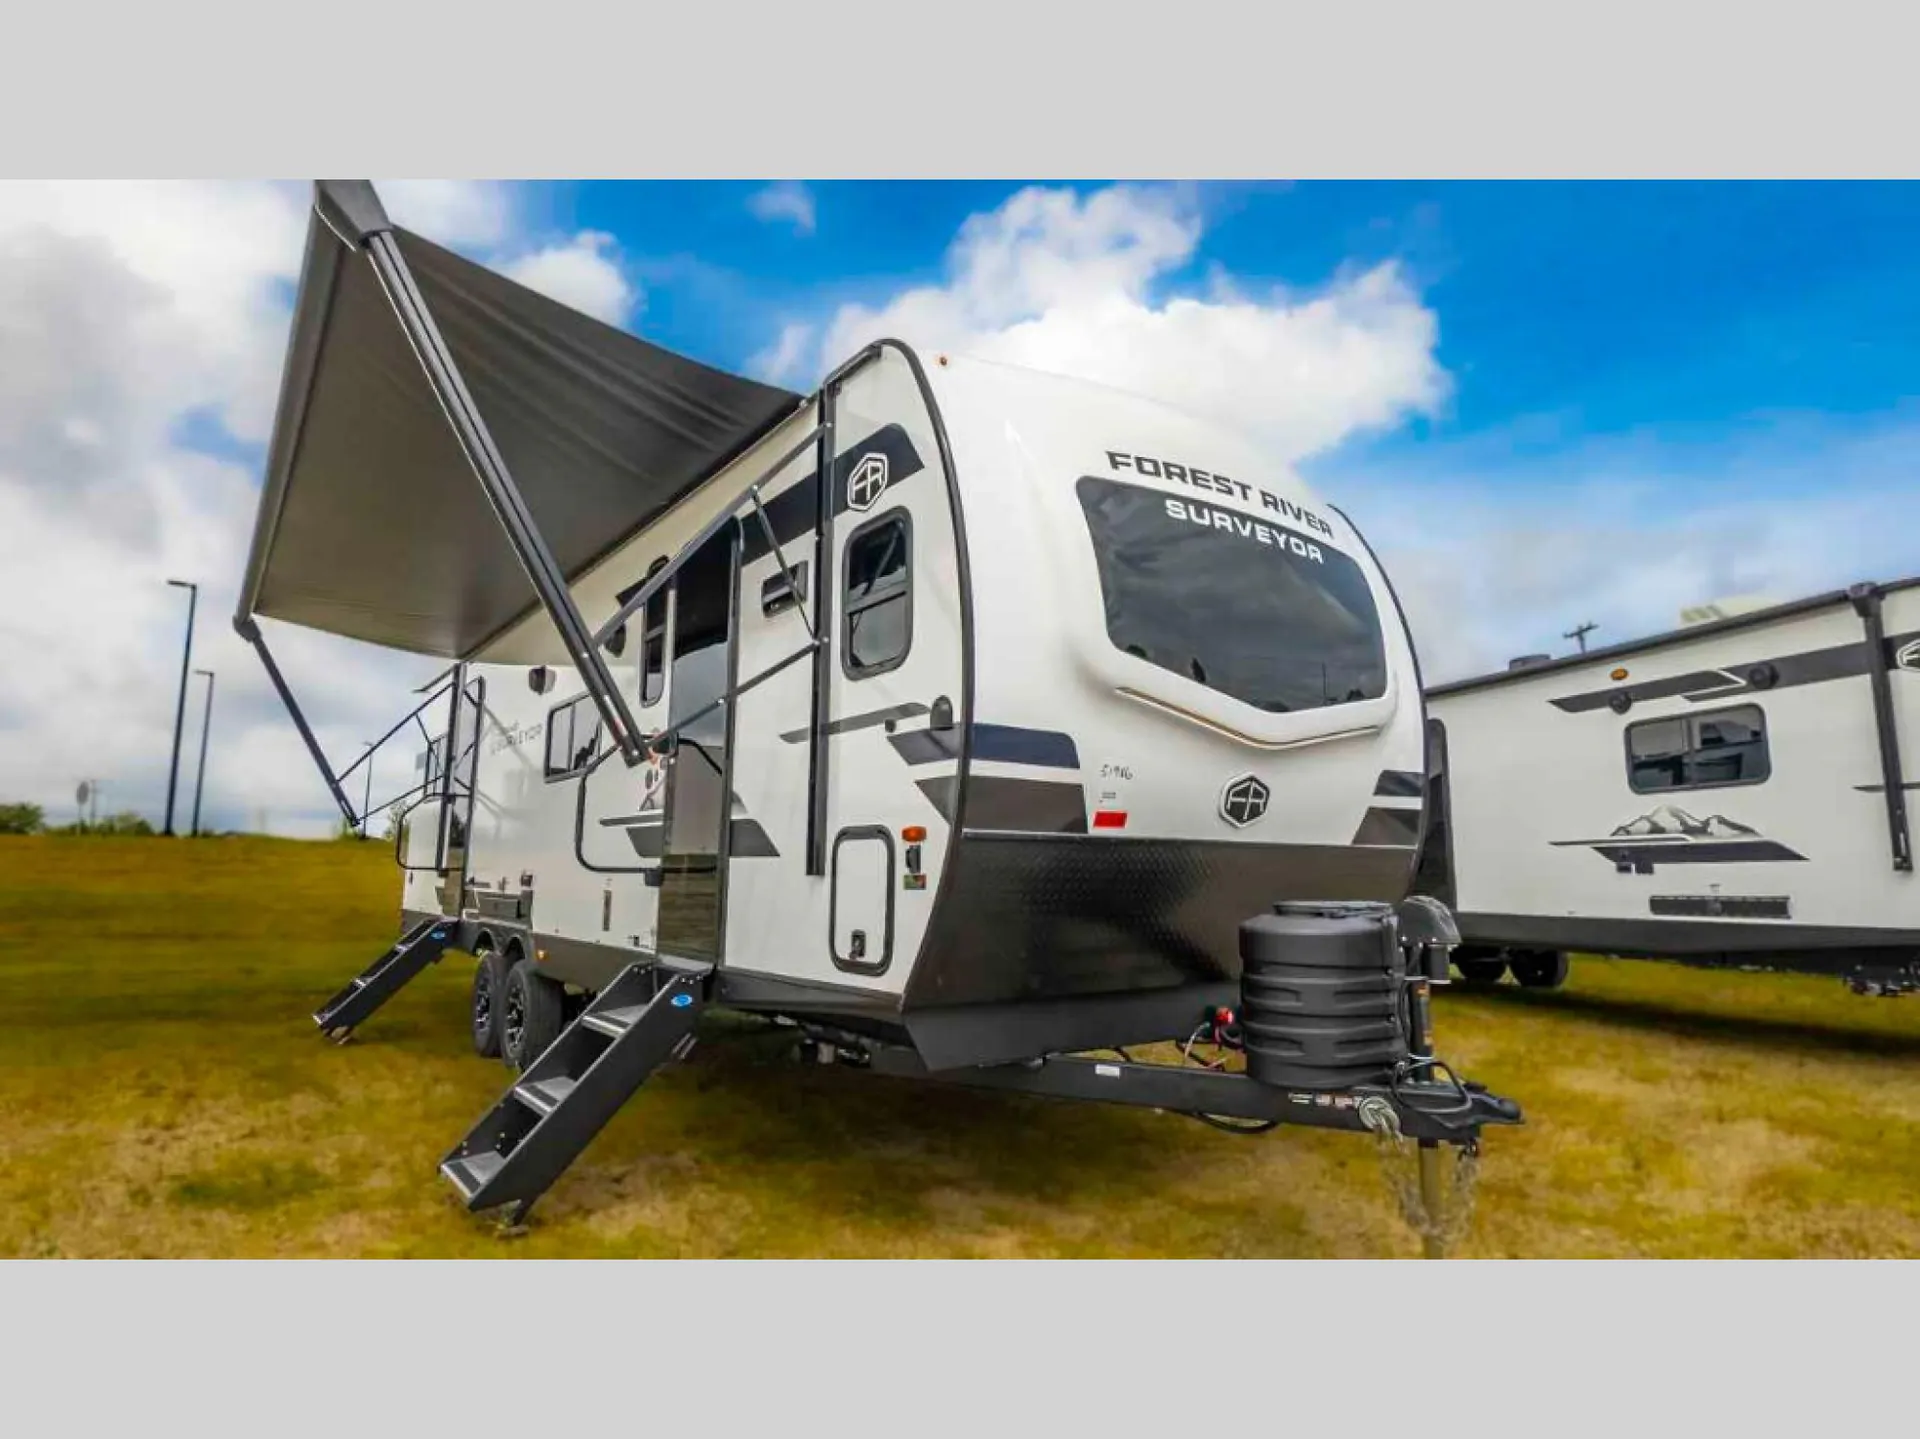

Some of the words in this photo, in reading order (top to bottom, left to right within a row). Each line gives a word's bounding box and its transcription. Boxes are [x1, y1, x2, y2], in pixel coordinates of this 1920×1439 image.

[1105, 450, 1252, 502] FOREST
[1259, 489, 1335, 540] RIVER
[1164, 498, 1324, 565] SURVEYOR
